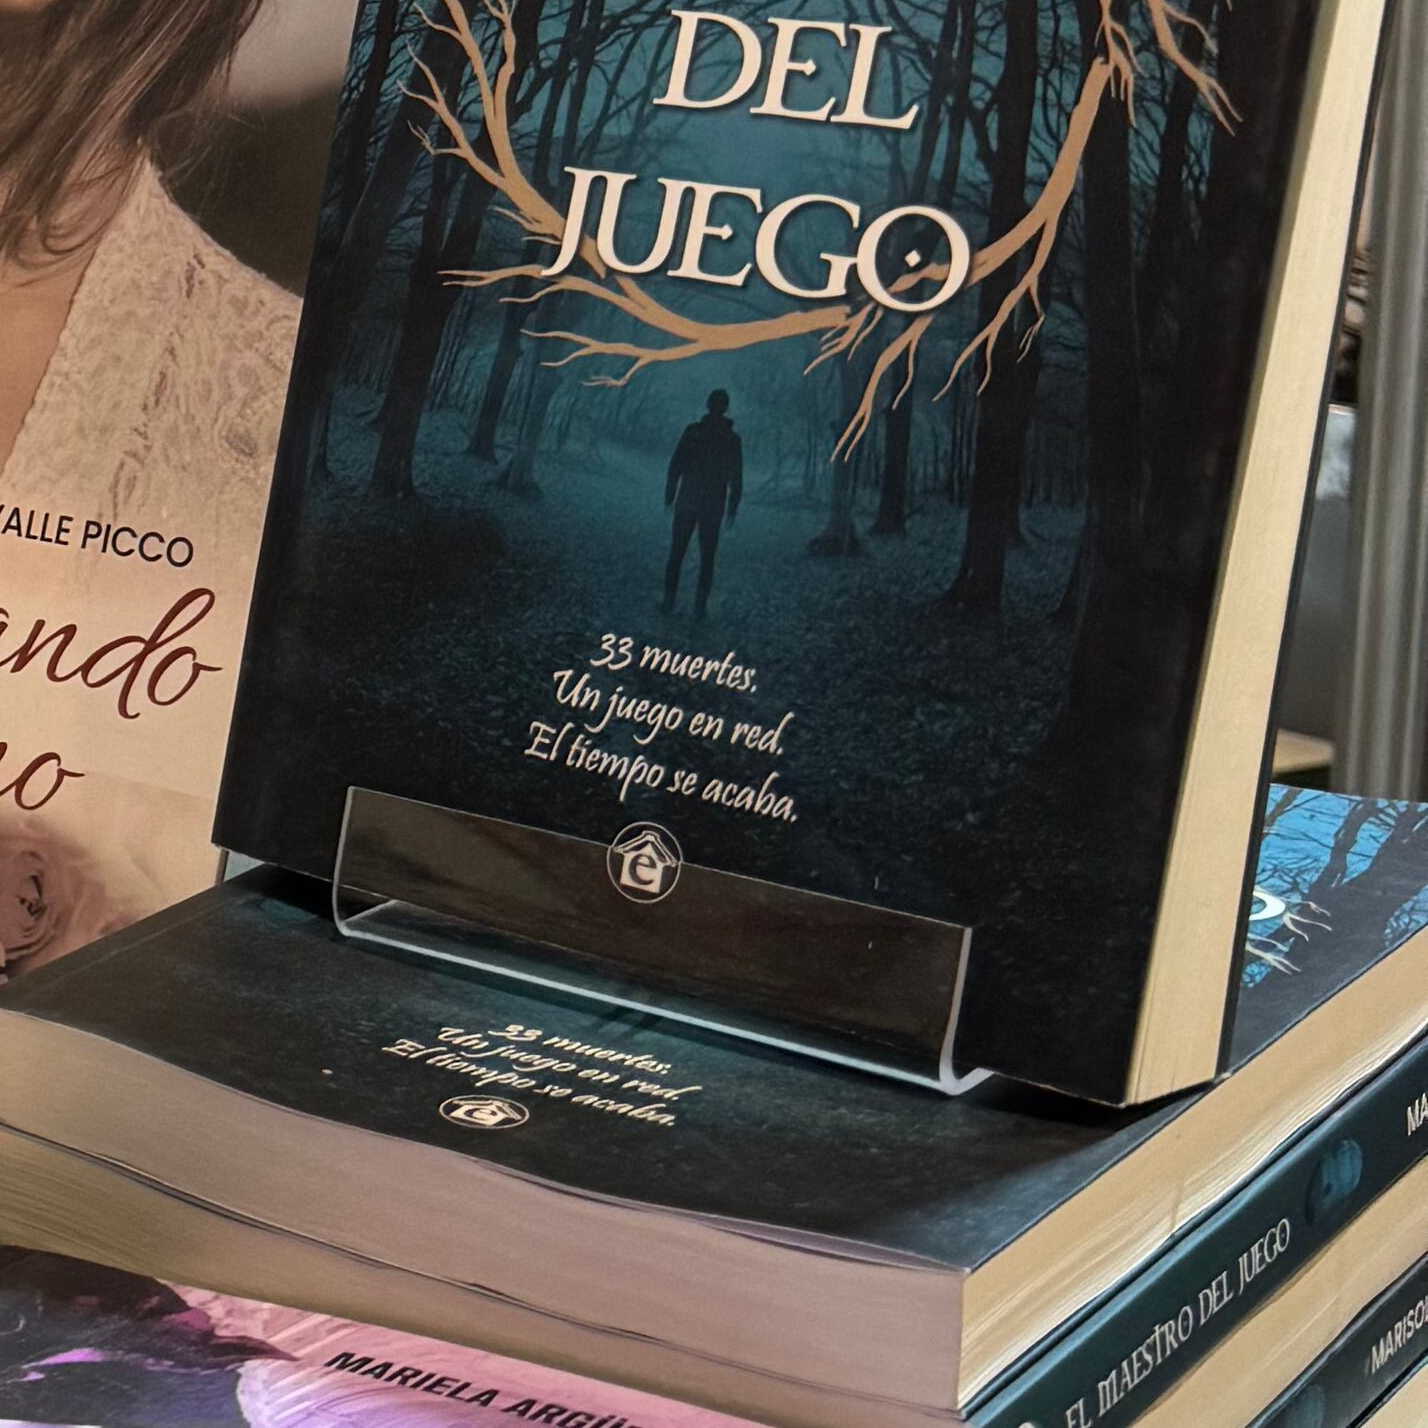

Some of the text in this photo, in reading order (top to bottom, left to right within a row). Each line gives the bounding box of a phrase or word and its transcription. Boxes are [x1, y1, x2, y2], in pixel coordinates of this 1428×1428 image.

[652, 8, 920, 130] DEL
[540, 165, 971, 313] JUEGO
[79, 520, 195, 569] PICCO
[590, 632, 758, 694] 33 muertes.
[552, 668, 795, 756] Un juego en red.
[524, 720, 798, 824] El tiempo se acaba.
[381, 1038, 676, 1127] El tiempo se acaba.
[437, 1026, 703, 1101] Un juego en red.
[487, 1023, 673, 1075] 33 muertes.
[1096, 1305, 1194, 1417] MAESTRO
[1198, 1269, 1236, 1328] DEL
[1238, 1216, 1293, 1296] JUEGO
[324, 1350, 646, 1428] MARIELA ARGÜ
